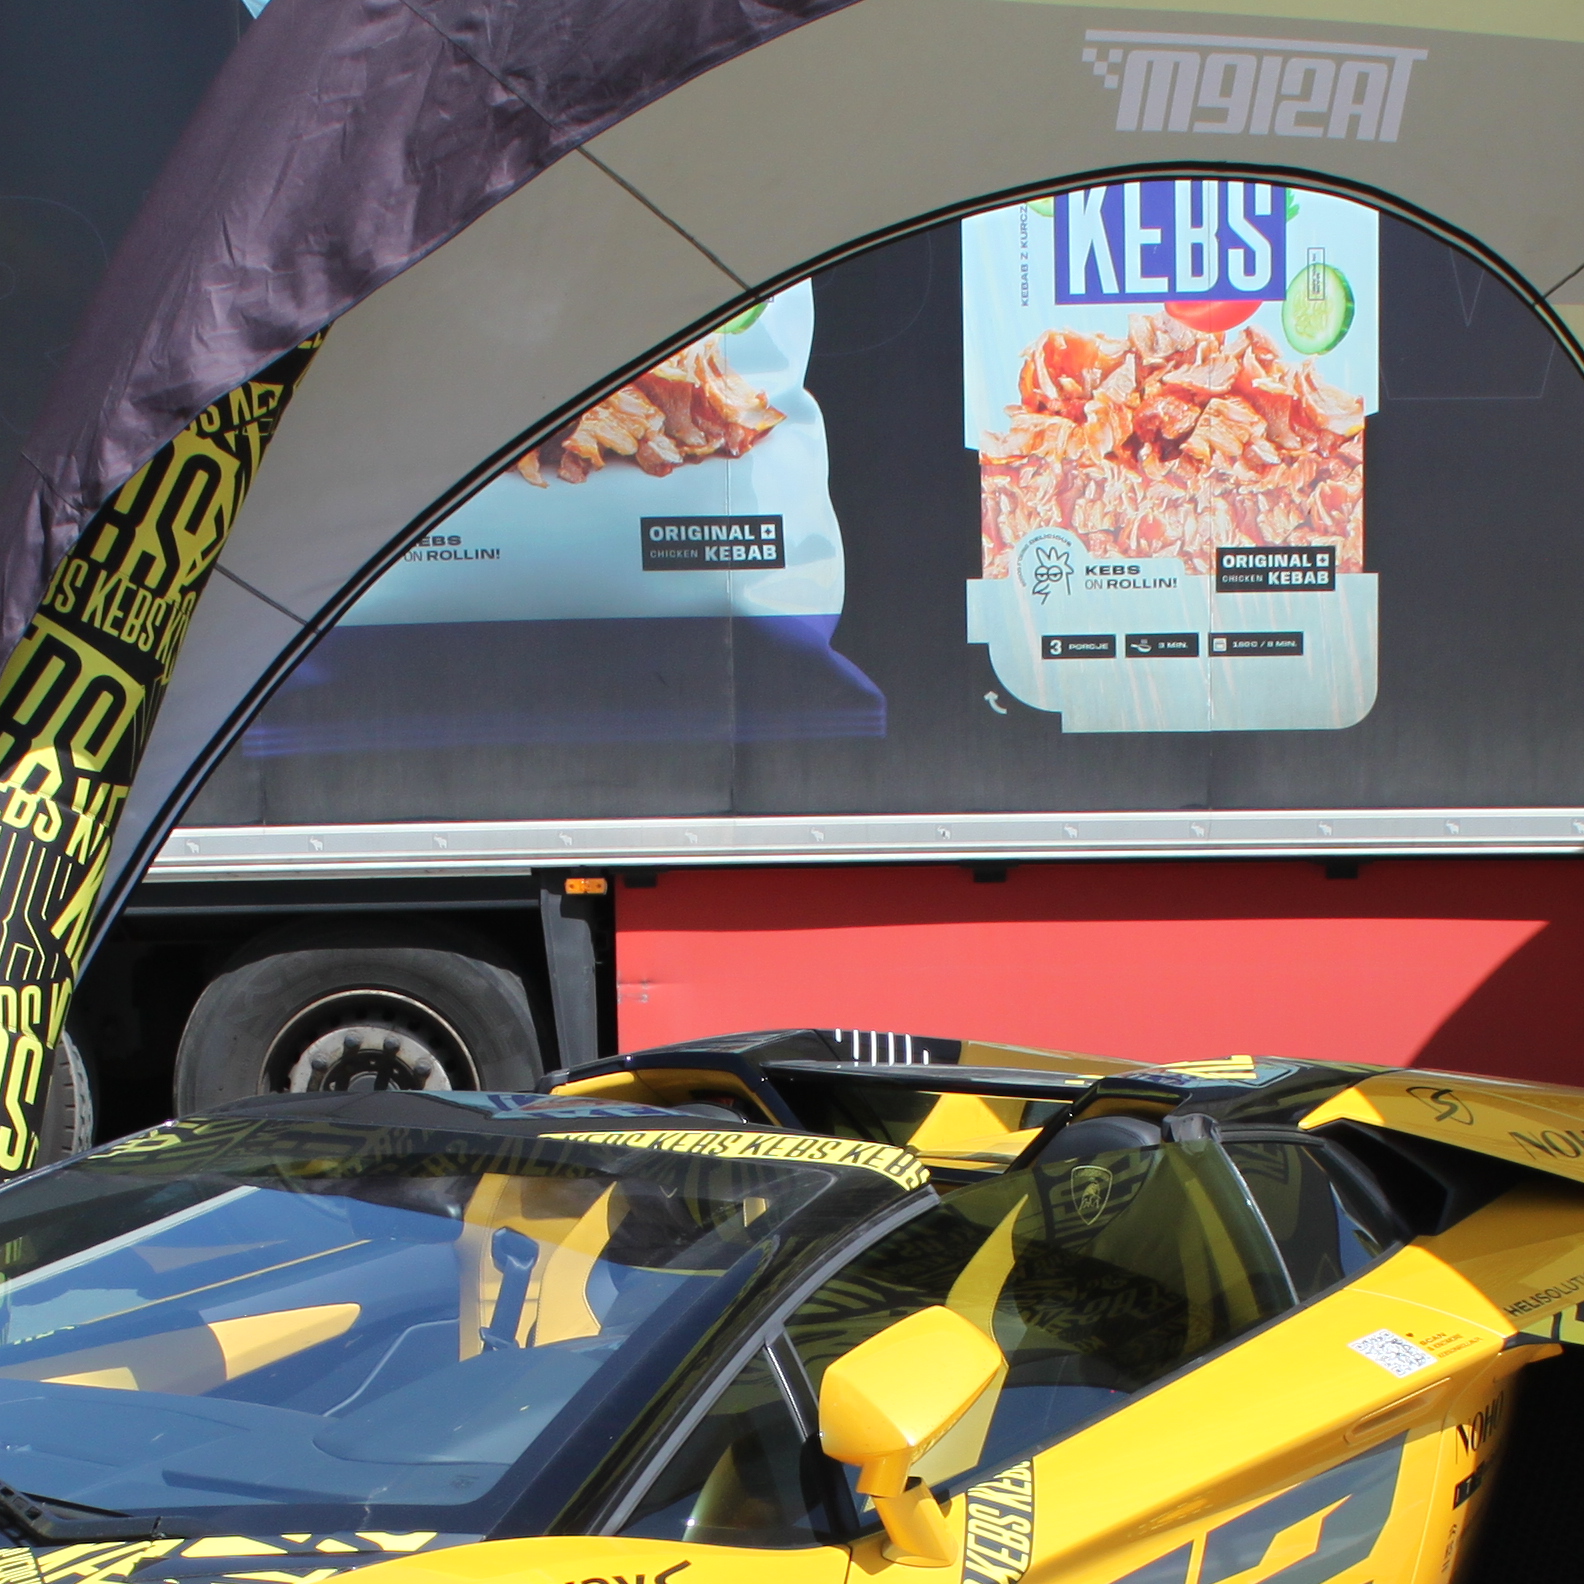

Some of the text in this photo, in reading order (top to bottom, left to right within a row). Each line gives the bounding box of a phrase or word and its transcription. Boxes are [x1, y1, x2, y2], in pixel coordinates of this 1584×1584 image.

[1068, 179, 1272, 296] KEBS
[1020, 263, 1029, 307] KEBAB
[650, 525, 755, 541] ORIGINAL
[416, 535, 461, 546] EBS
[404, 548, 500, 562] ON ROLLIN!
[650, 546, 777, 562] CHICKEN KEBAB
[1222, 554, 1312, 568] ORIGINAL
[1085, 565, 1141, 576] KEBS
[1085, 577, 1178, 589] ON ROLLIN!
[1222, 571, 1330, 585] CHICKEN KEBAB
[1050, 640, 1108, 655] 3 PORCJE
[743, 1134, 841, 1160] KEBS
[843, 1143, 932, 1191] KEBS
